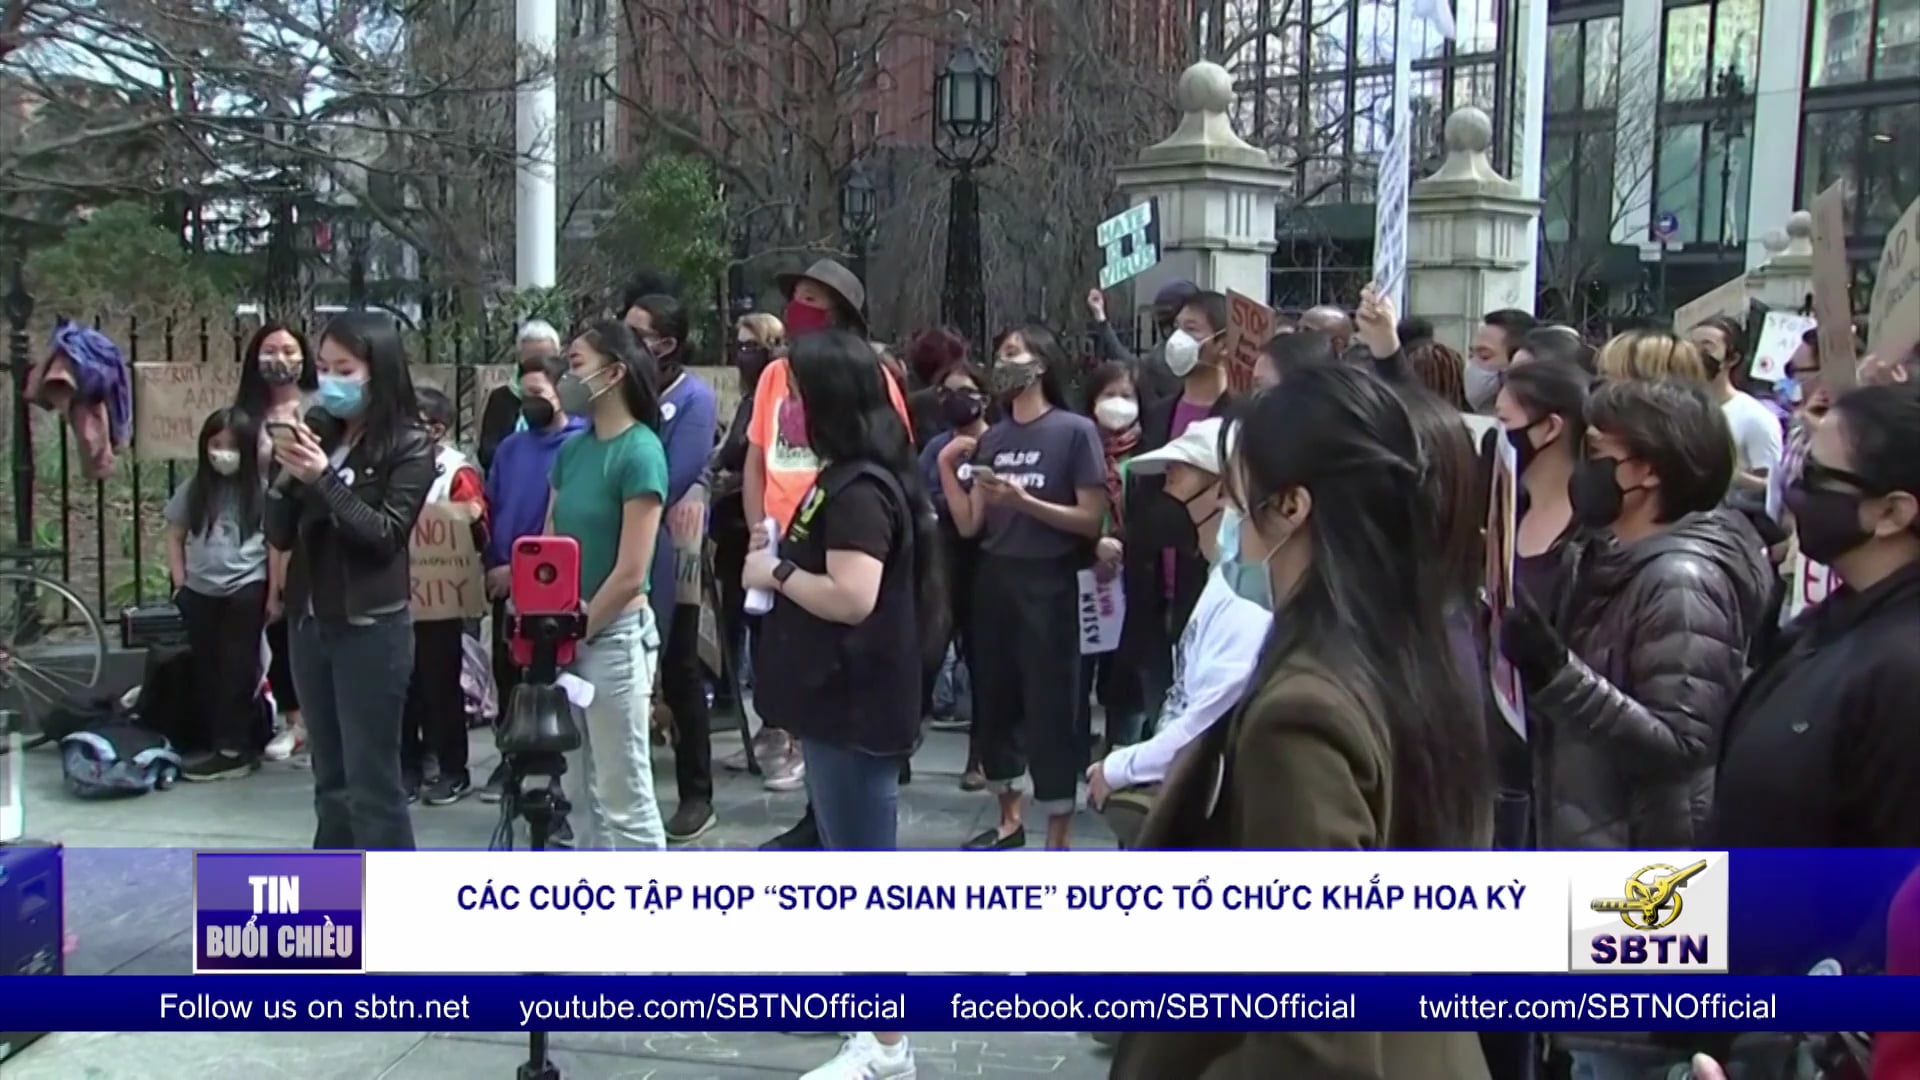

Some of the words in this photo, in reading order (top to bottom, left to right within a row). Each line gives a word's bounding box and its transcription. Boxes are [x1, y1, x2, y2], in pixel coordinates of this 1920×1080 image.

[1099, 205, 1149, 247] HATE
[1100, 244, 1157, 289] VIRUS
[1231, 297, 1269, 337] STOP
[1025, 451, 1040, 466] OF
[1081, 592, 1100, 644] ASIAN
